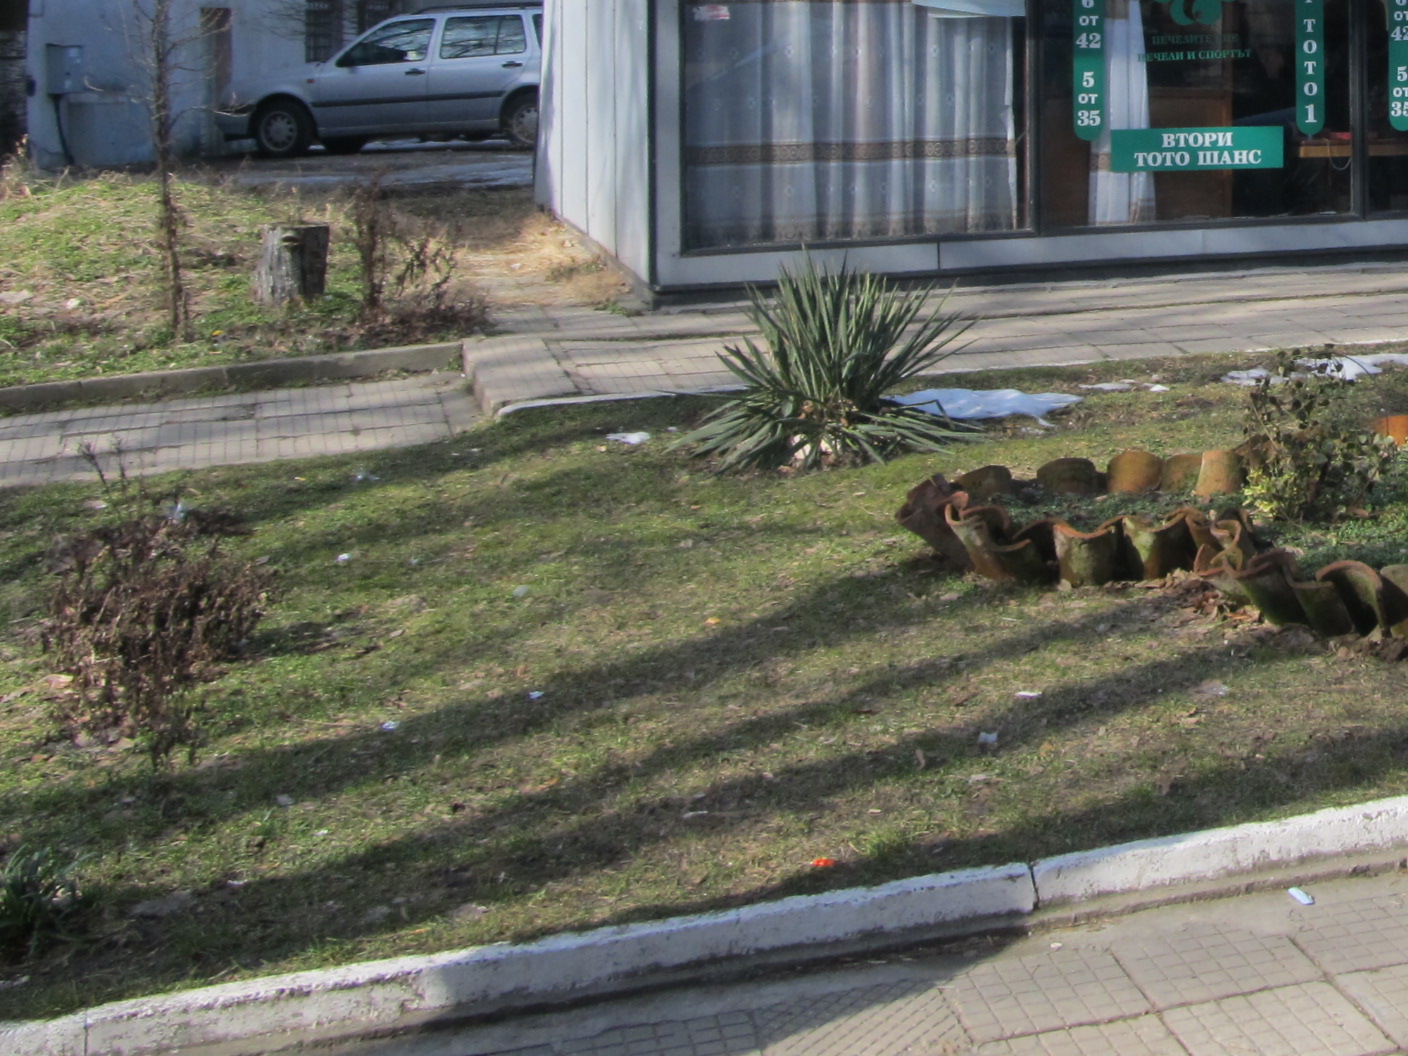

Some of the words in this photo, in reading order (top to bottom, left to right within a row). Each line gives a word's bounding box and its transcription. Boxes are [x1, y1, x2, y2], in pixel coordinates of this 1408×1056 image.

[1079, 16, 1098, 25] от
[1076, 33, 1100, 48] 42
[1198, 49, 1252, 60] СПОРТЪТ
[1303, 19, 1317, 96] ТОТО
[1083, 72, 1094, 87] 5
[1397, 66, 1407, 81] 5
[1078, 94, 1098, 104] от
[1078, 110, 1100, 126] 35
[1305, 104, 1317, 122] 1
[1163, 132, 1232, 147] ВТОРИ
[1134, 152, 1190, 166] ТОТО
[1198, 150, 1261, 165] ШАНС
